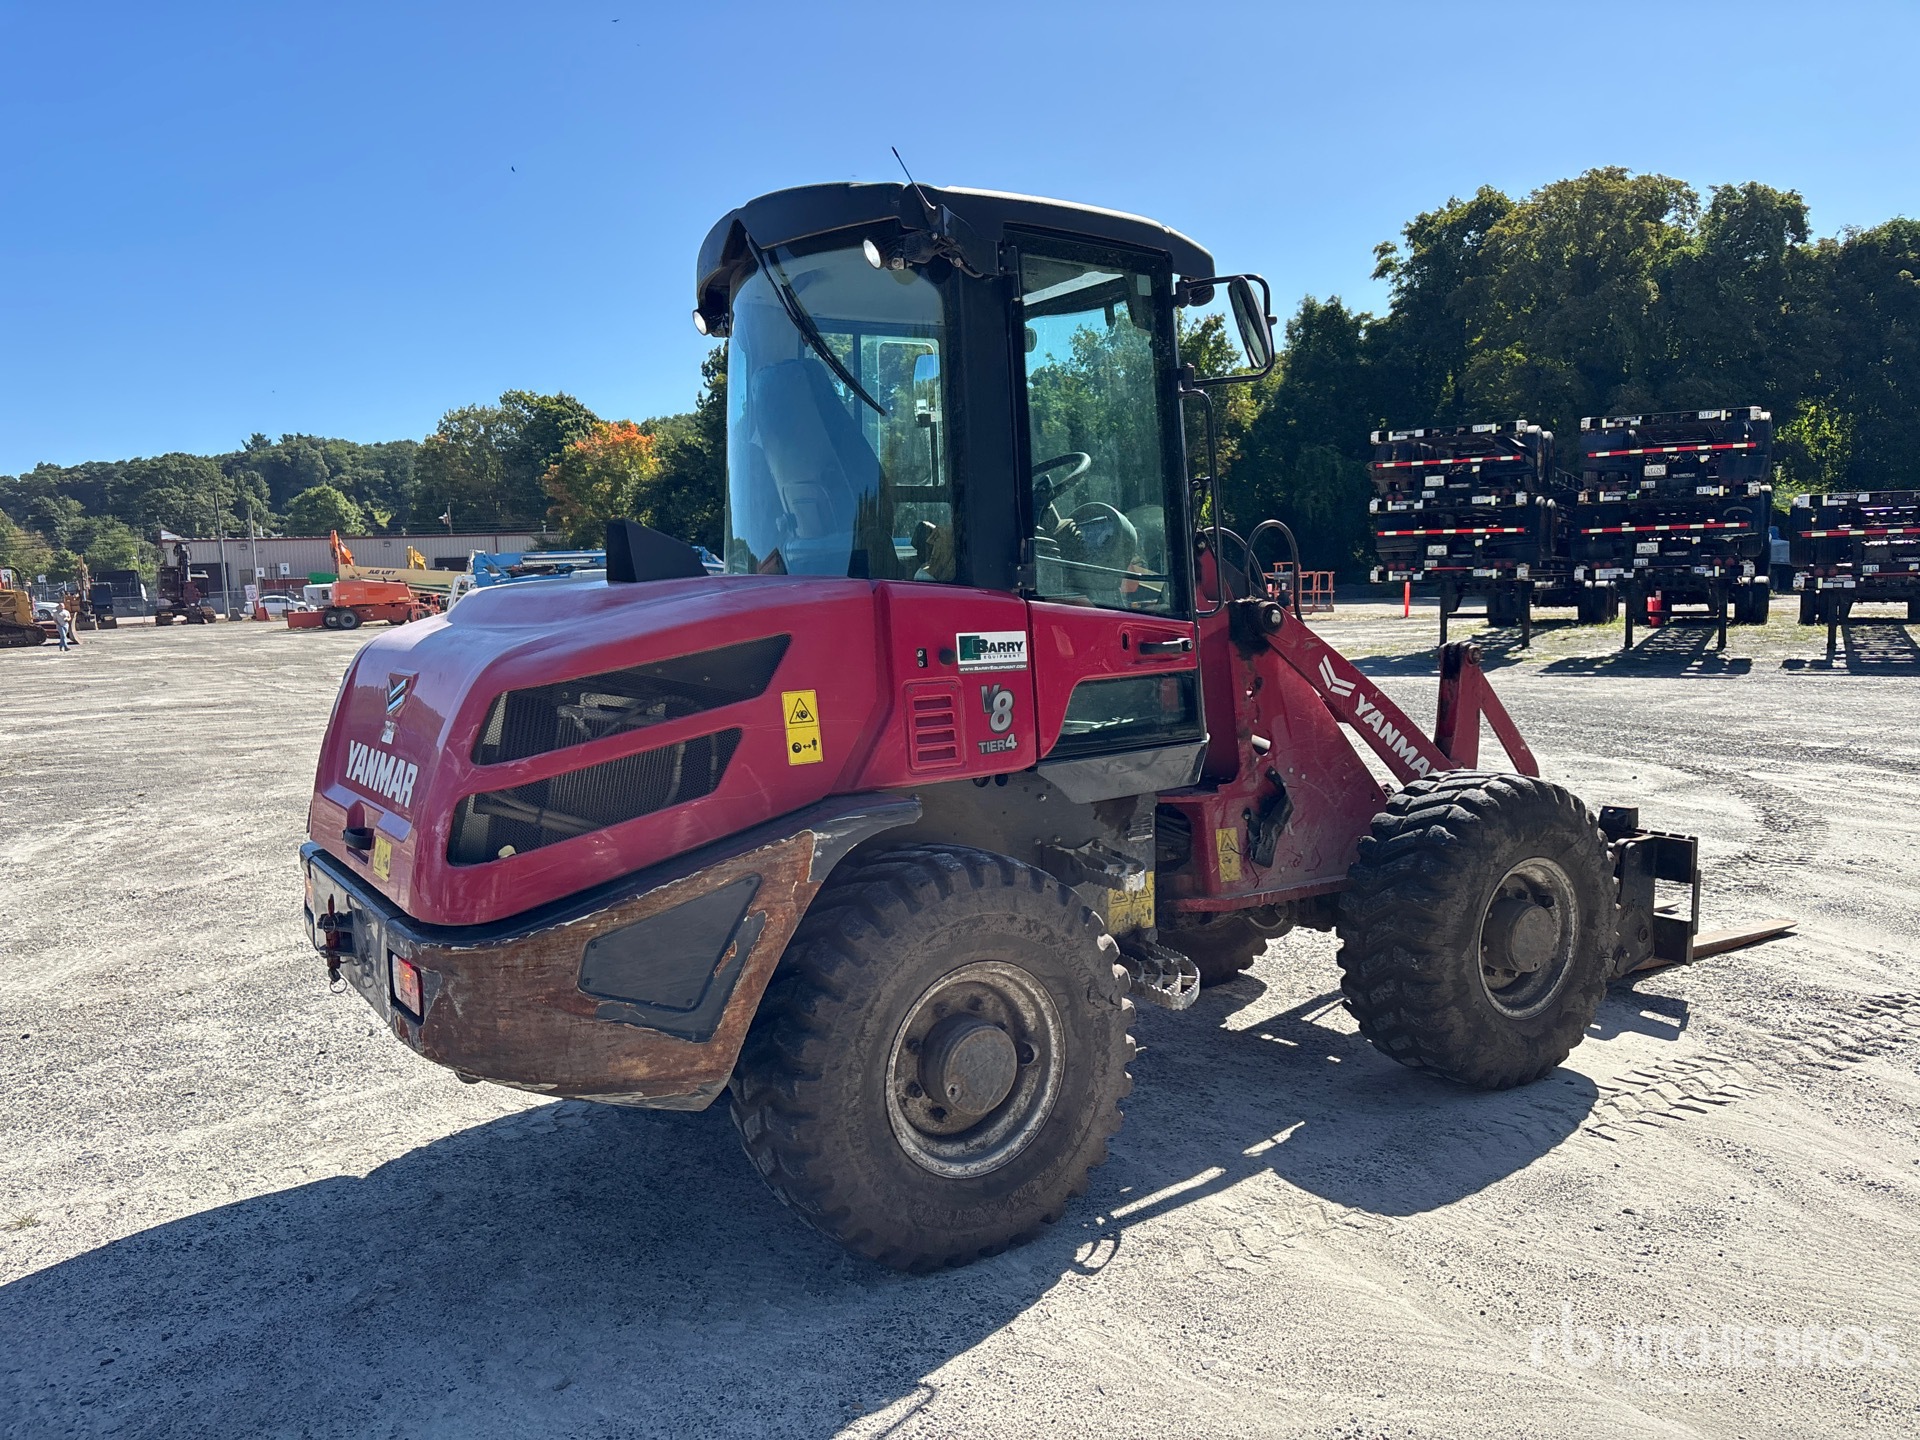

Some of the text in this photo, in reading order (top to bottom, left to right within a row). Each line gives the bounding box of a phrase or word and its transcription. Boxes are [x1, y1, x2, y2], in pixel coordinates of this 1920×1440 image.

[972, 638, 1024, 654] BARRY
[1354, 692, 1439, 779] YANMA
[345, 739, 419, 808] YANMAR
